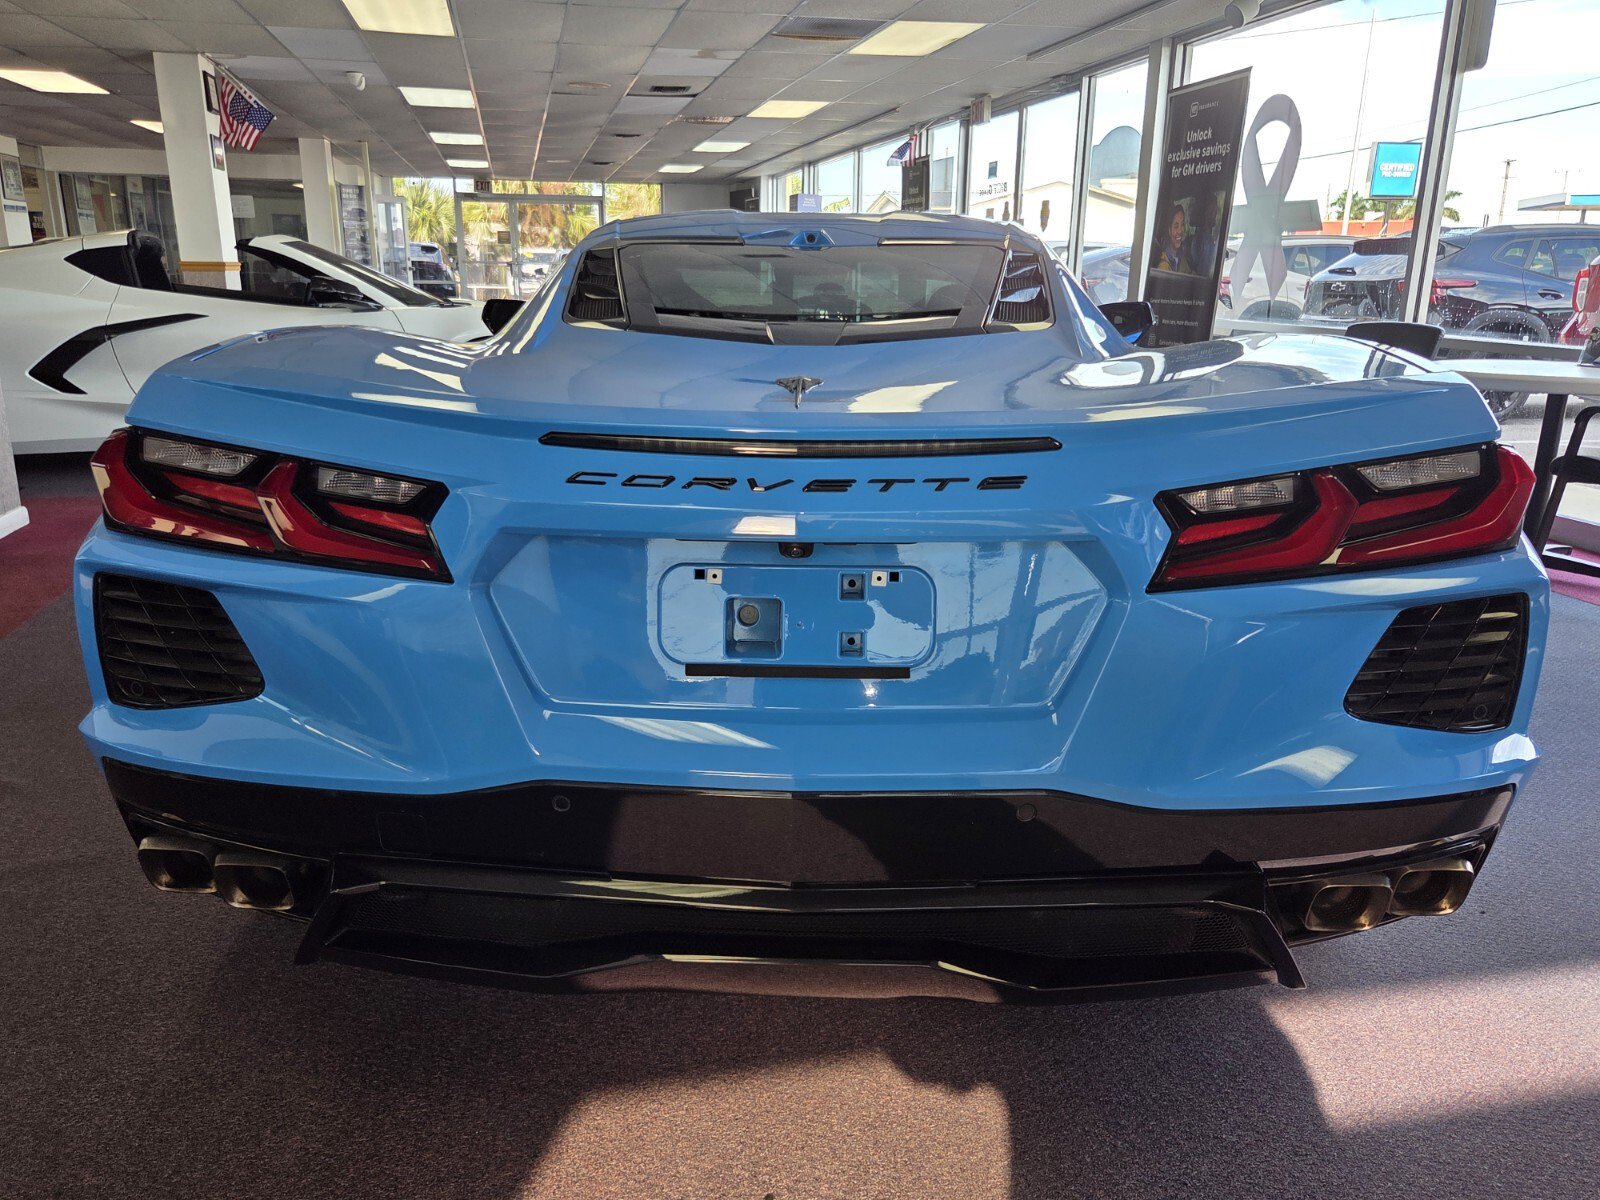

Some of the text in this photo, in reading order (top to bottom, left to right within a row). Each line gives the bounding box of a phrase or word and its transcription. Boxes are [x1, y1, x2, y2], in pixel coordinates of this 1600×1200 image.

[1187, 126, 1213, 143] Unlock
[1167, 142, 1231, 162] exclusive savings
[1171, 161, 1222, 178] for GM drivers
[475, 180, 490, 192] EXIT
[565, 470, 1028, 493] CORVETTE
